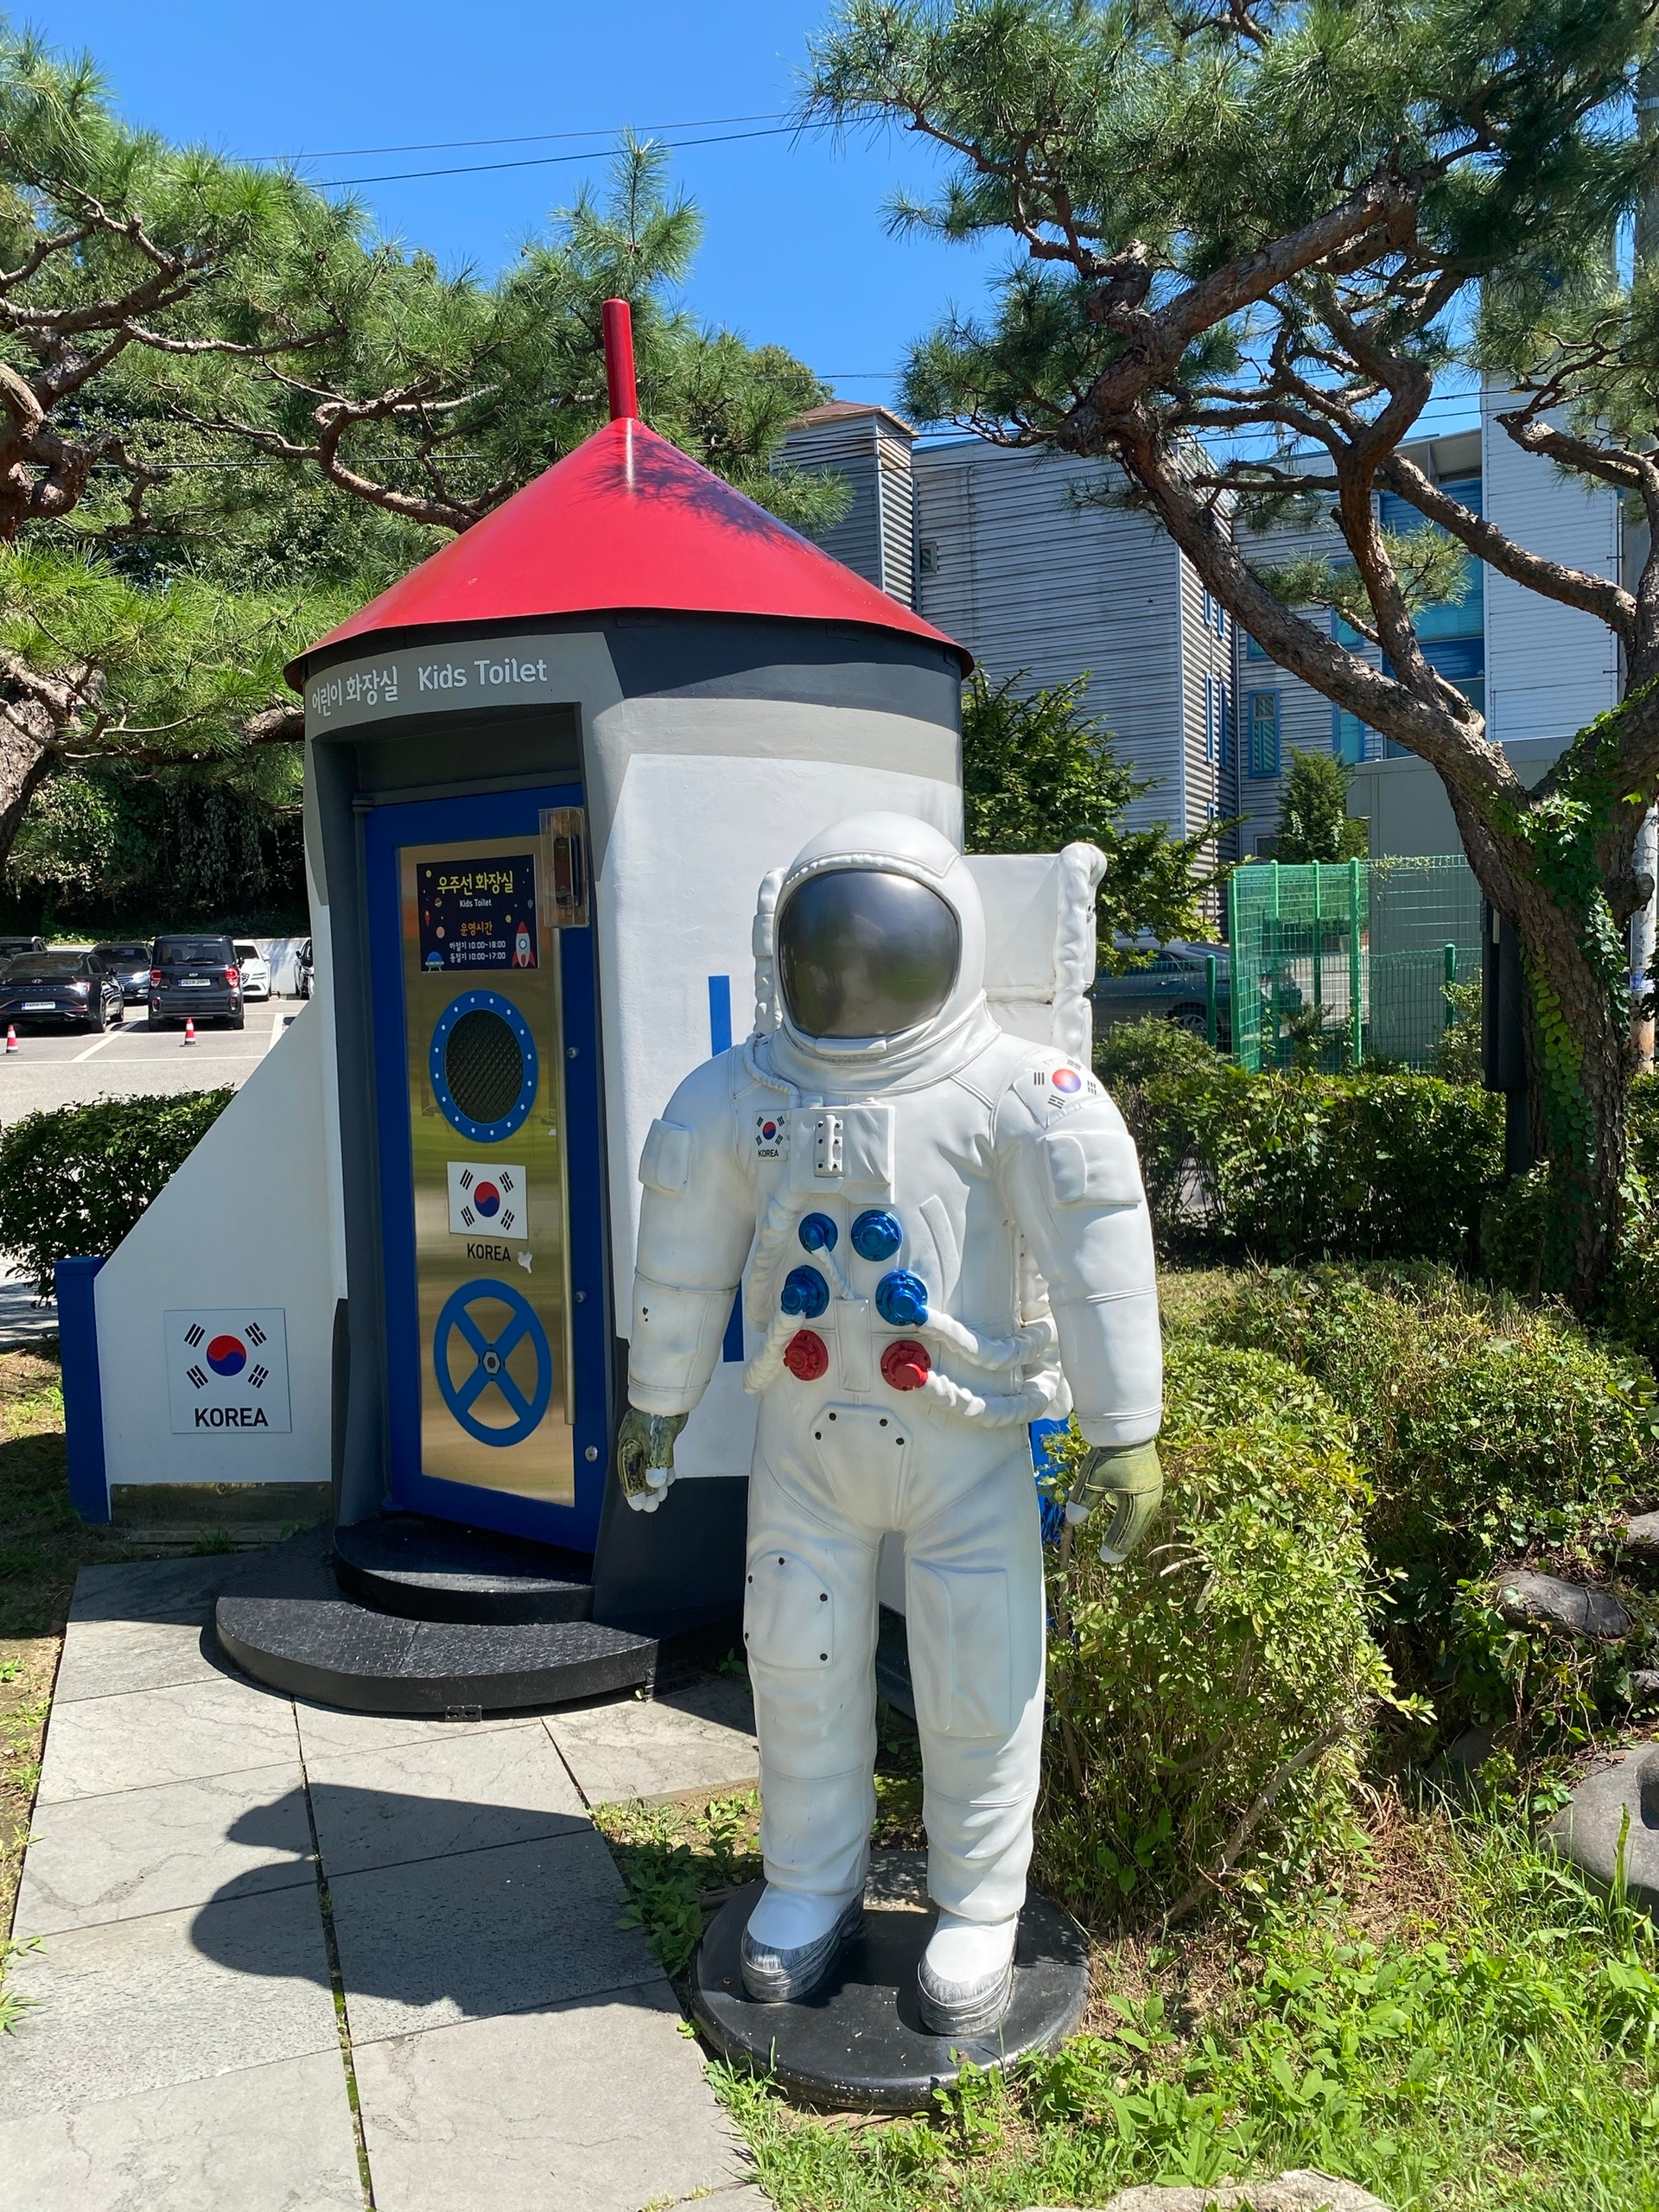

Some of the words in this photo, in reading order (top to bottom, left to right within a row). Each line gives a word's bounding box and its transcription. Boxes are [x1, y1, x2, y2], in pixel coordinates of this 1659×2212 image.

[312, 679, 342, 716] 어린이
[346, 665, 398, 705] 화장실
[418, 663, 467, 691] Kids
[474, 658, 548, 685] Toilet
[437, 873, 473, 895] 우주선
[475, 870, 513, 894] 화장실
[474, 899, 492, 907] Toilet
[460, 921, 493, 937] 운영시간
[758, 1149, 779, 1158] KOREA
[467, 1243, 512, 1262] KOREA
[194, 1408, 270, 1427] KOREA
